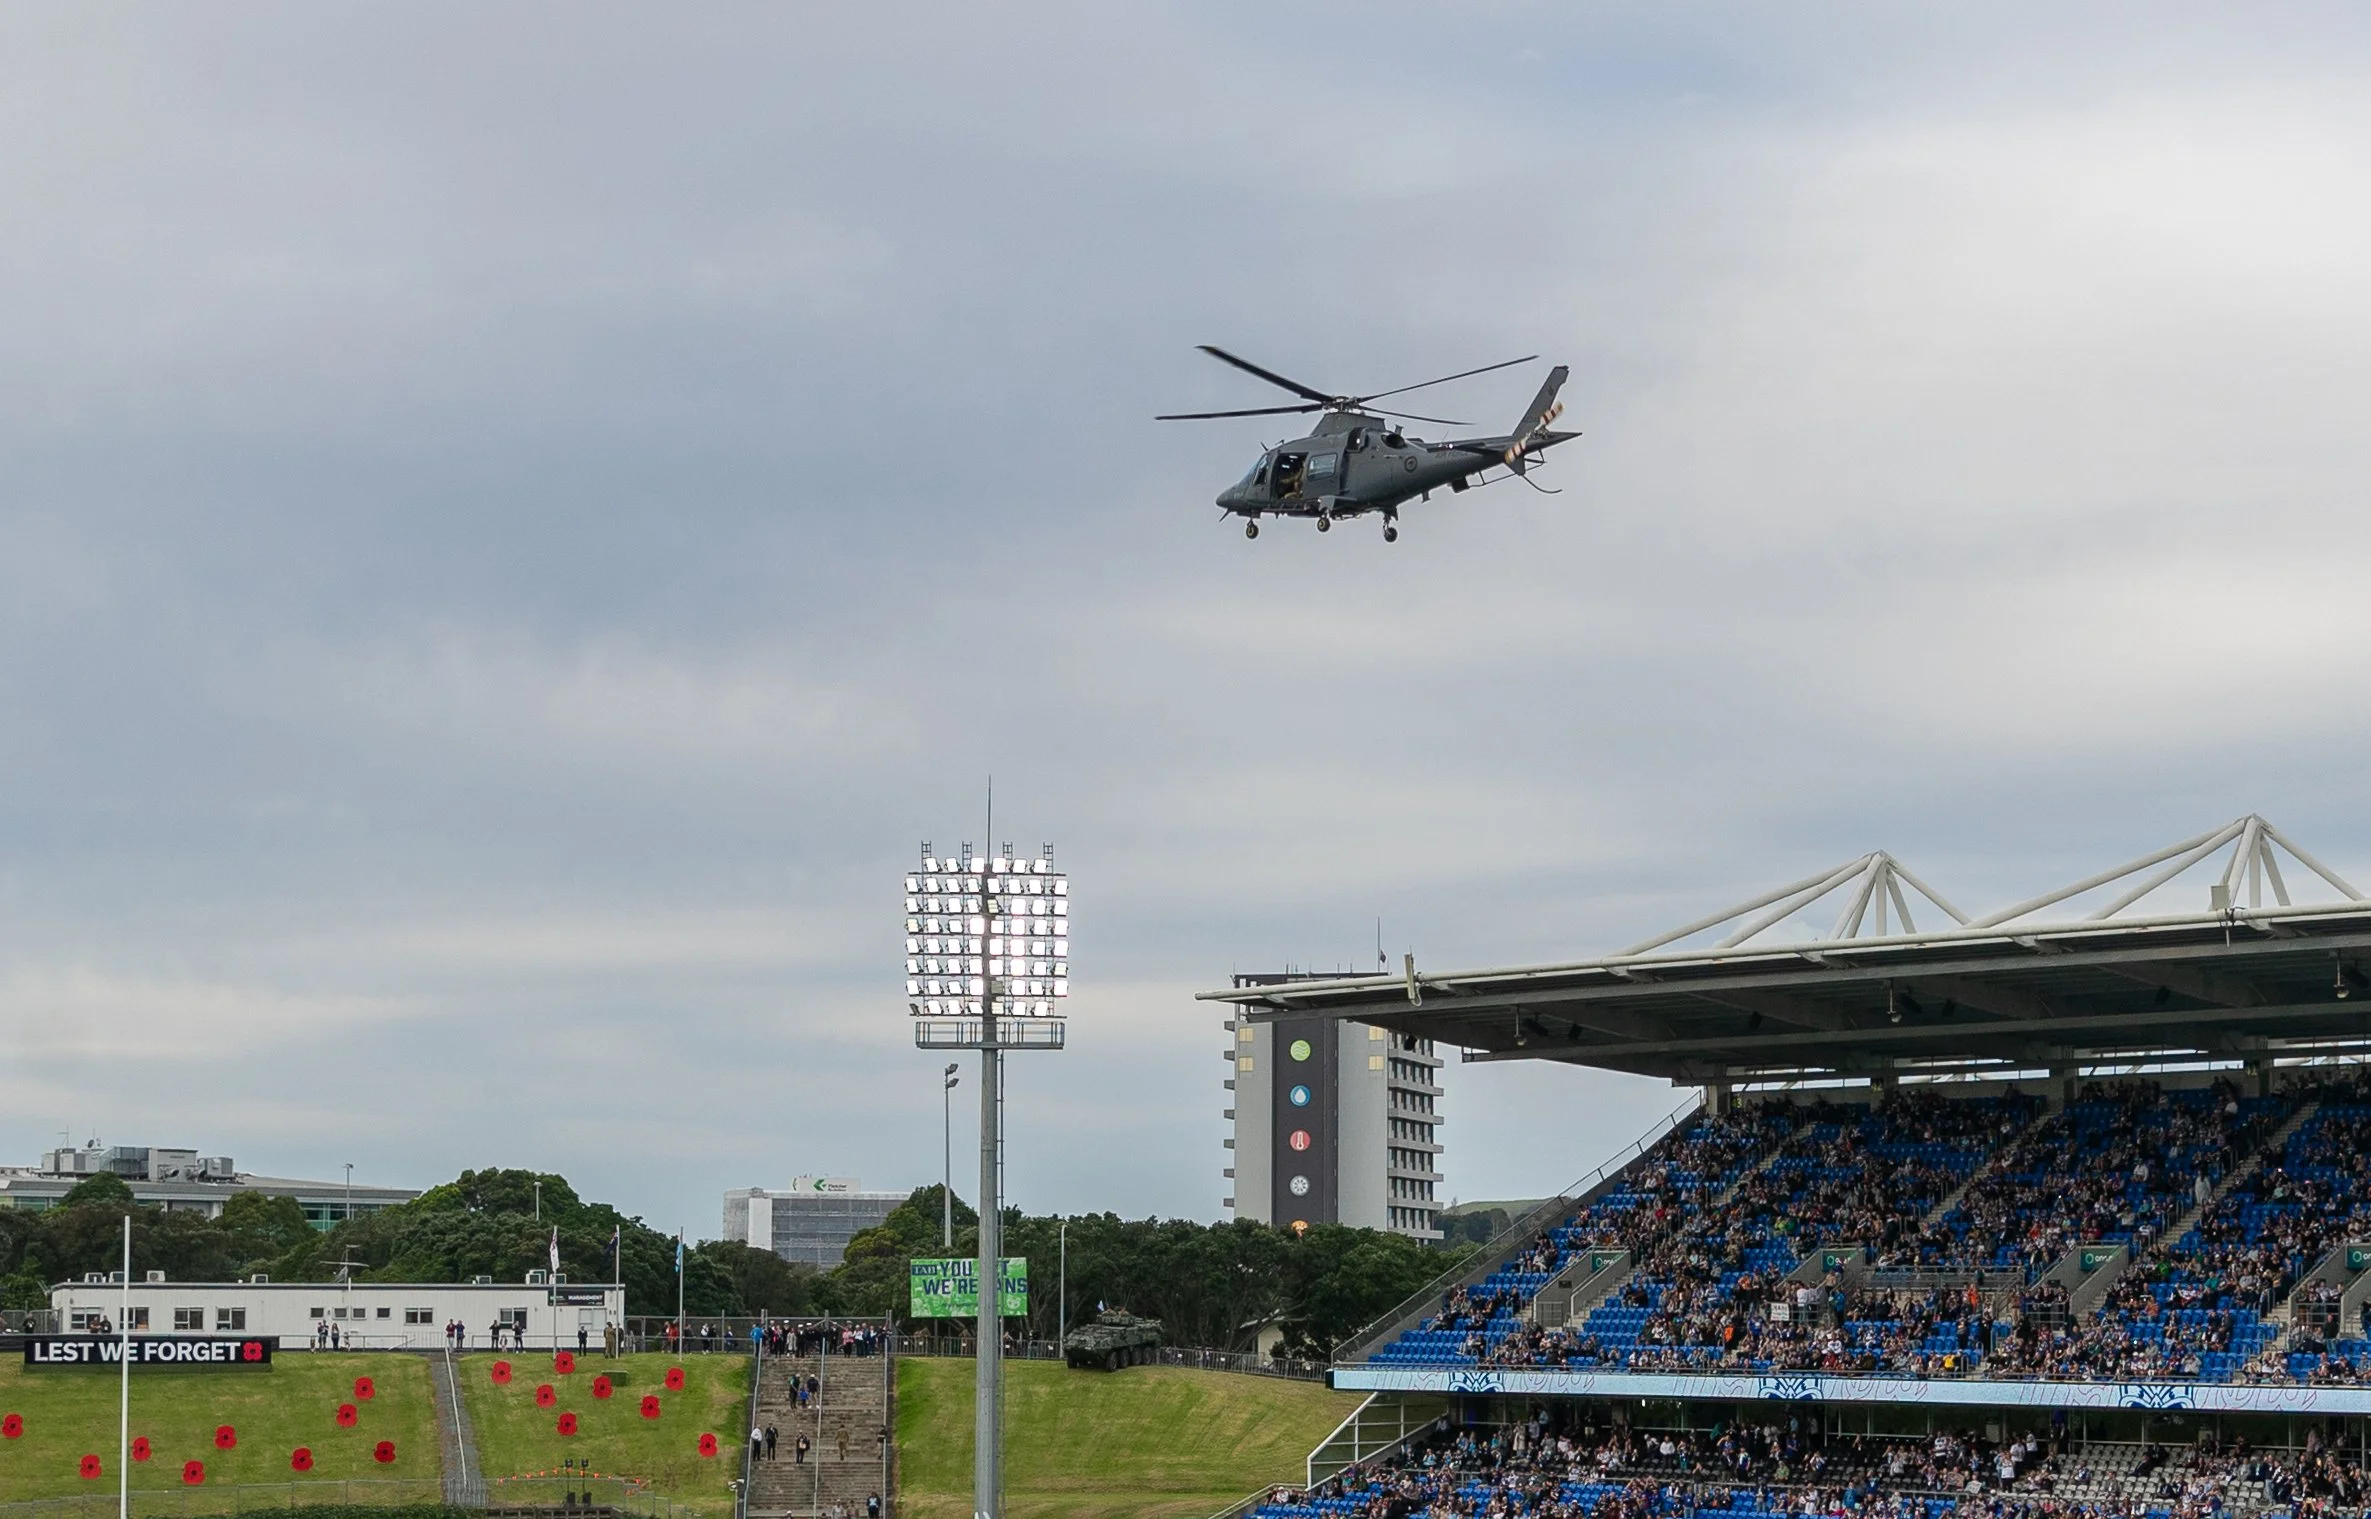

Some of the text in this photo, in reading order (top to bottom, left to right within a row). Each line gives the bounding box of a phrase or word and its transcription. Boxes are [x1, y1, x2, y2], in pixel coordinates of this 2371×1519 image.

[914, 1265, 936, 1275] TAB
[940, 1261, 972, 1277] YOU
[923, 1277, 1028, 1295] WE'RE ANS
[34, 1342, 241, 1361] LEST WE FORGET
